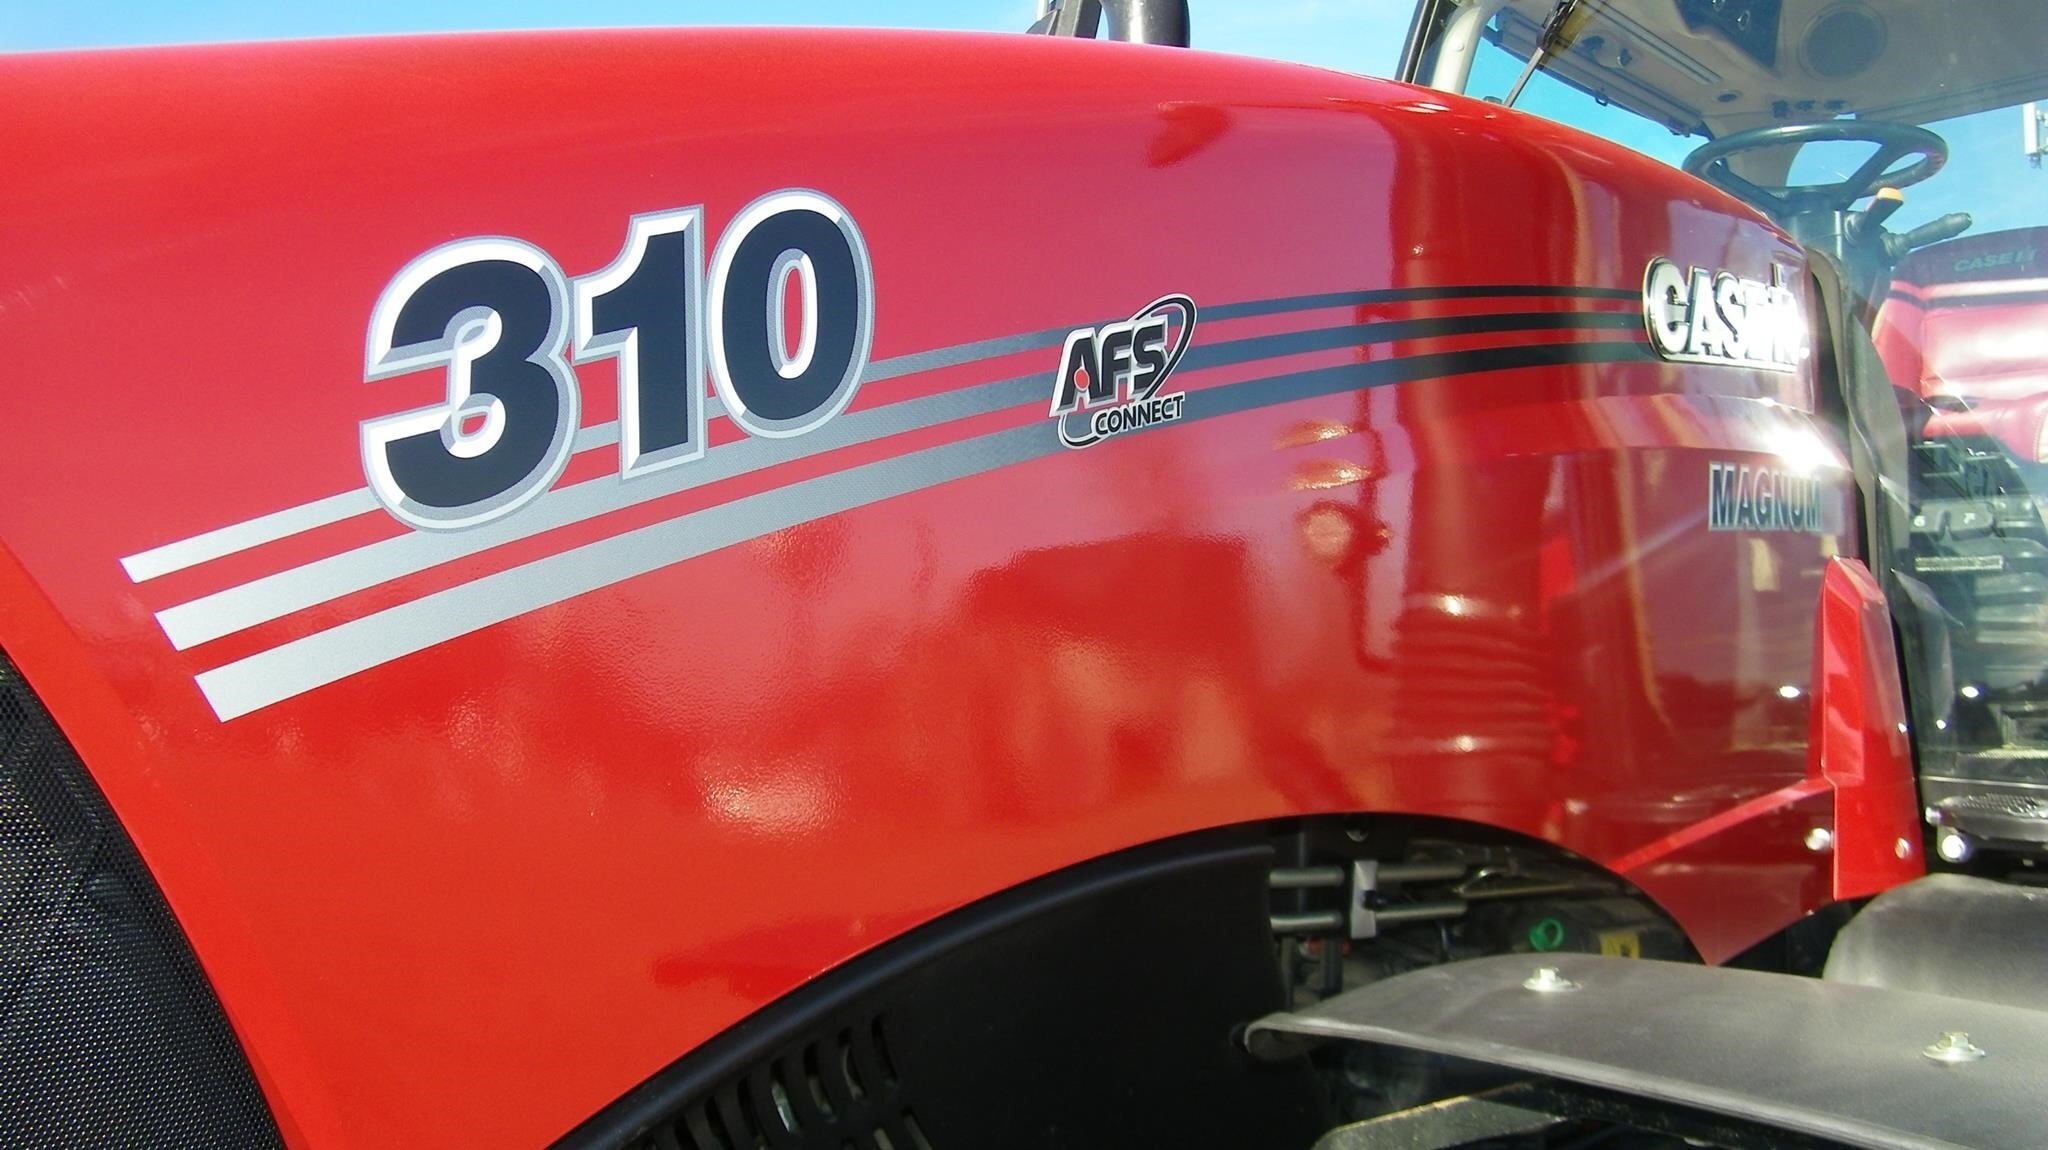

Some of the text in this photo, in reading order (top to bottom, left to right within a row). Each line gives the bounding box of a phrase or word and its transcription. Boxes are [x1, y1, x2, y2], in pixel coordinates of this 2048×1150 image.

[360, 187, 874, 534] 310
[1049, 315, 1168, 417] AFS
[1092, 391, 1185, 437] CONNECT
[1709, 462, 1824, 533] MAGNUM
